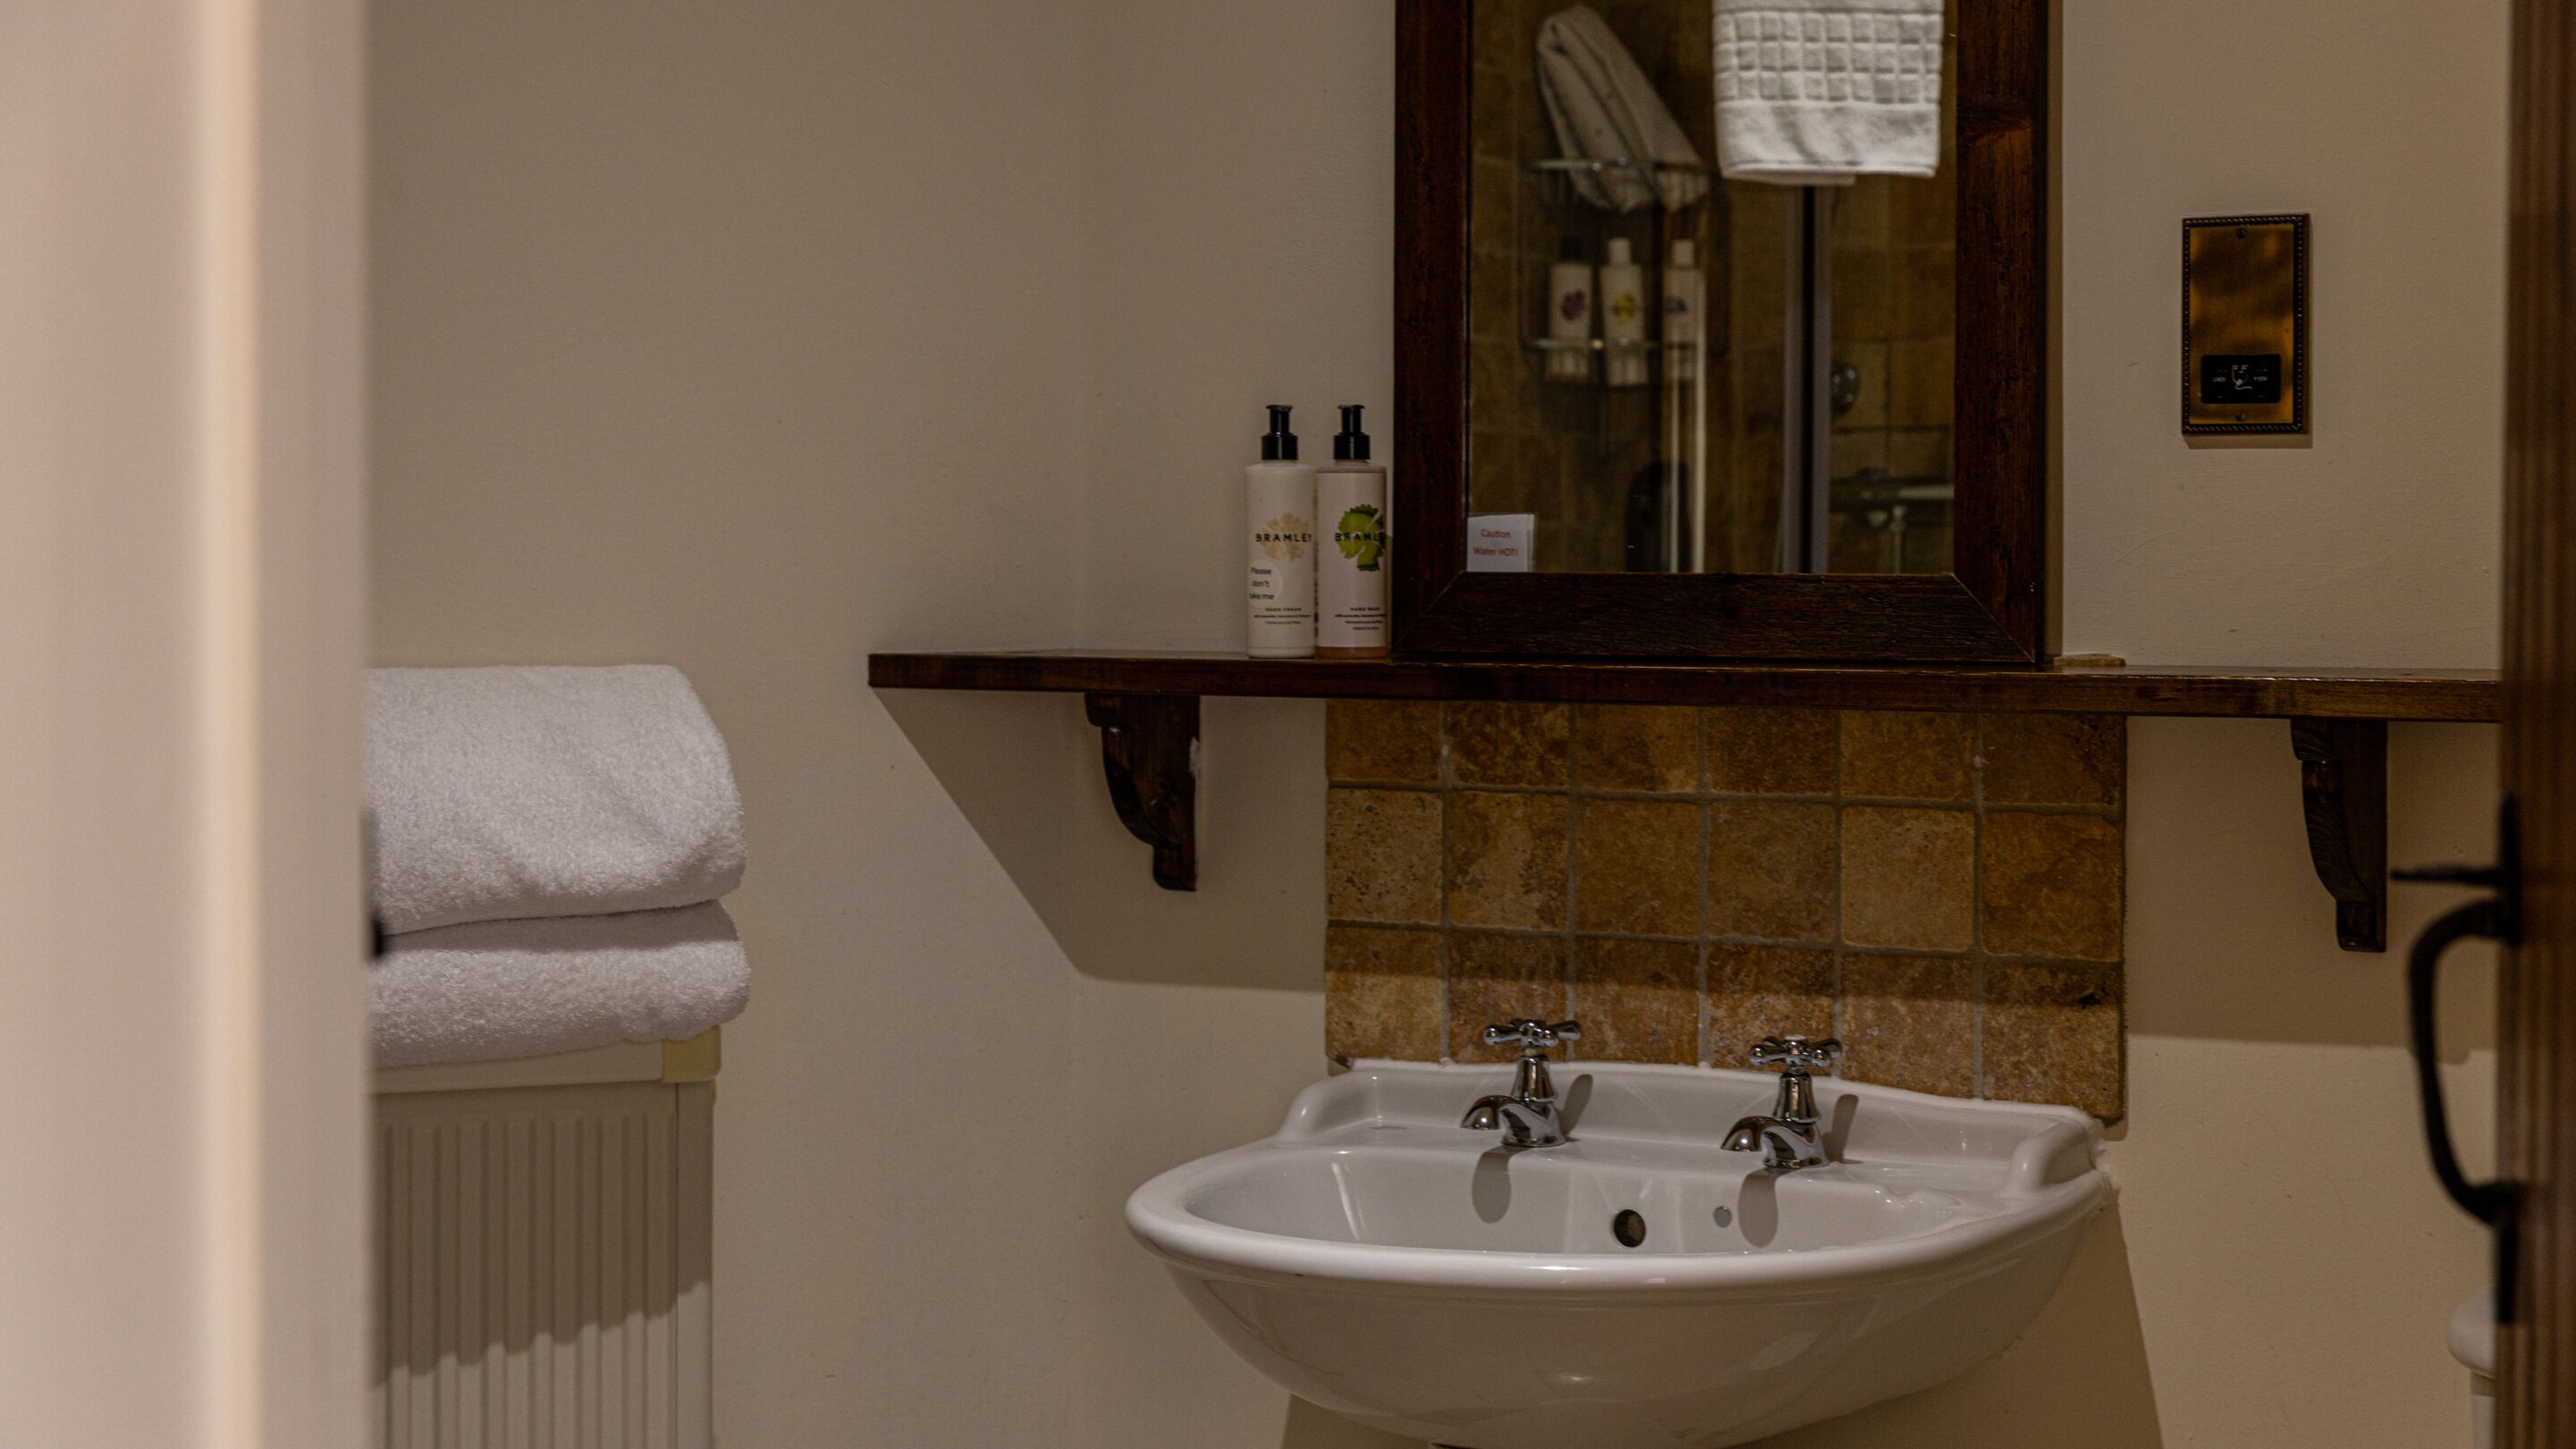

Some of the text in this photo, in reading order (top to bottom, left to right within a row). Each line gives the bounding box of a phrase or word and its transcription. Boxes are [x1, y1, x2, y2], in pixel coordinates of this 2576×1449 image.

[1481, 529, 1510, 537] Caution
[1474, 547, 1517, 557] Water HOT!
[1251, 567, 1271, 575] Please
